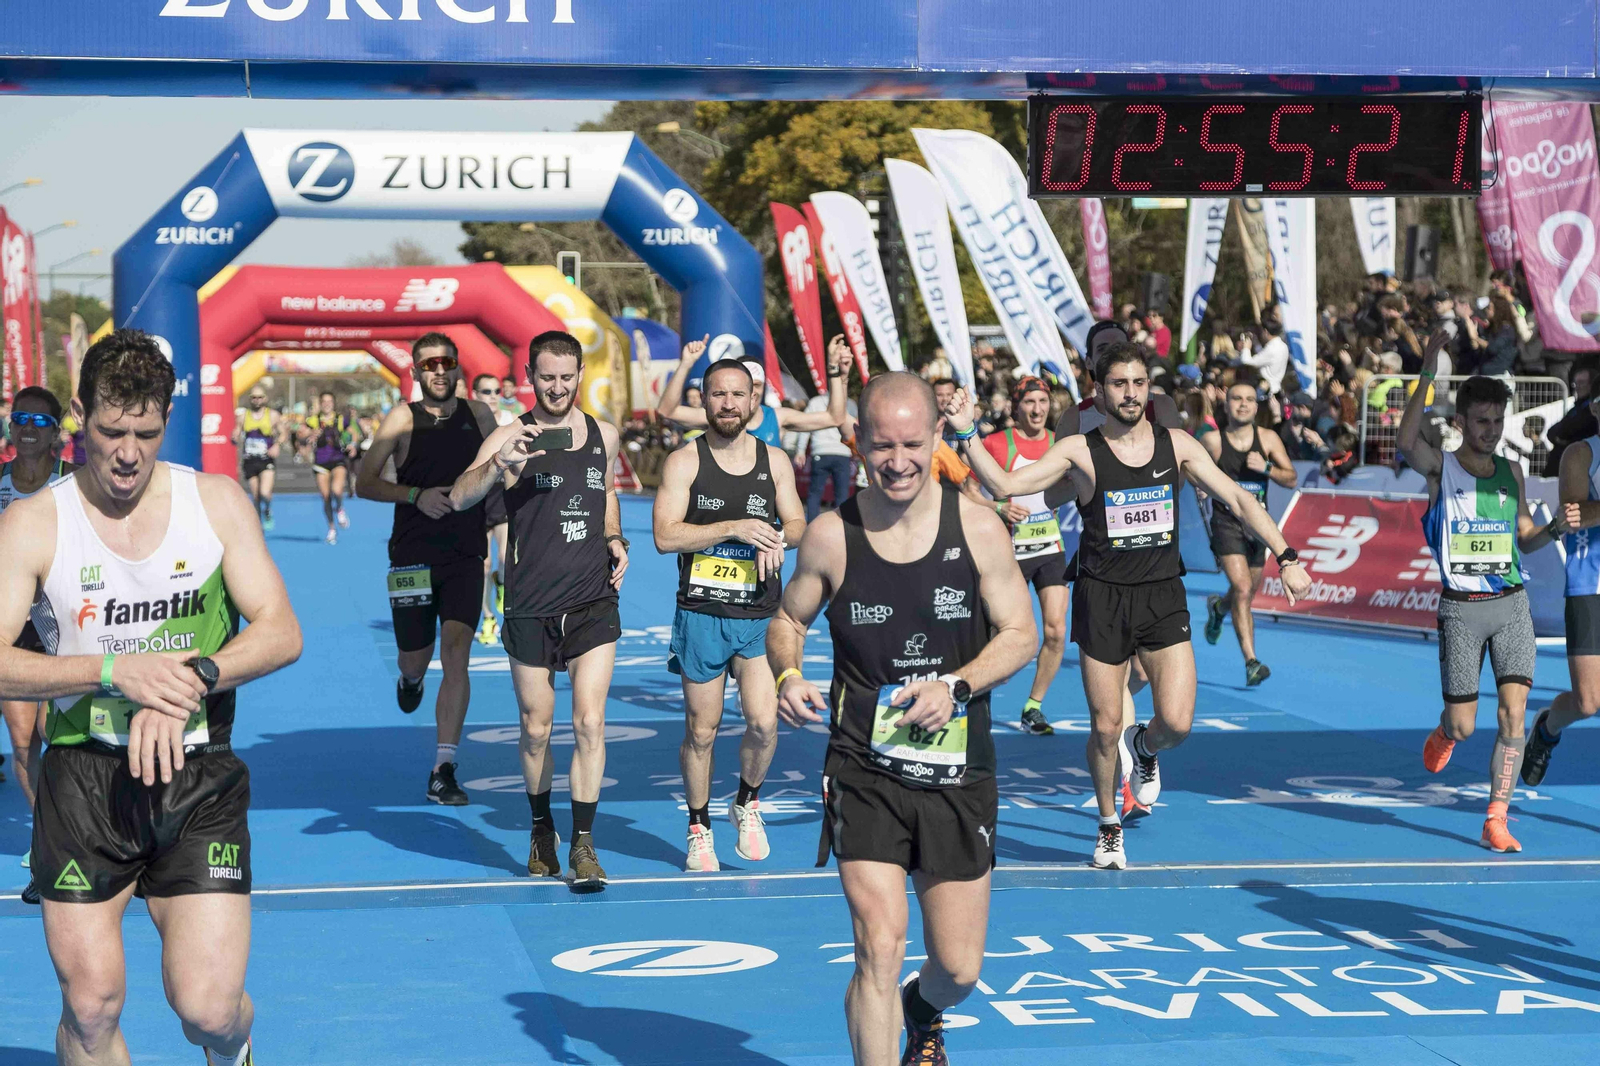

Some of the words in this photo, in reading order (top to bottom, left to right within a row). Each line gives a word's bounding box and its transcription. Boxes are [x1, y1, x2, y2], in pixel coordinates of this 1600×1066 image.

[381, 155, 571, 190] ZURICH
[155, 227, 234, 245] ZURICH
[642, 228, 718, 245] ZURICH
[281, 296, 315, 311] new
[317, 295, 386, 313] balance
[1128, 489, 1166, 502] ZURICH
[1124, 509, 1158, 525] 6481
[1030, 526, 1047, 537] 766
[1471, 523, 1505, 532] ZURICH
[716, 546, 751, 557] ZURICH
[1470, 540, 1493, 552] 621
[80, 565, 102, 583] CAT
[713, 564, 738, 579] 274
[396, 576, 415, 588] 658
[1369, 589, 1405, 608] new
[104, 589, 208, 627] fanatik
[850, 602, 893, 624] Priego
[892, 656, 942, 668] Topridel.es
[908, 723, 949, 746] 827
[939, 777, 961, 785] ZURICH
[208, 842, 240, 867] CAT
[209, 867, 242, 880] TORELLÓ
